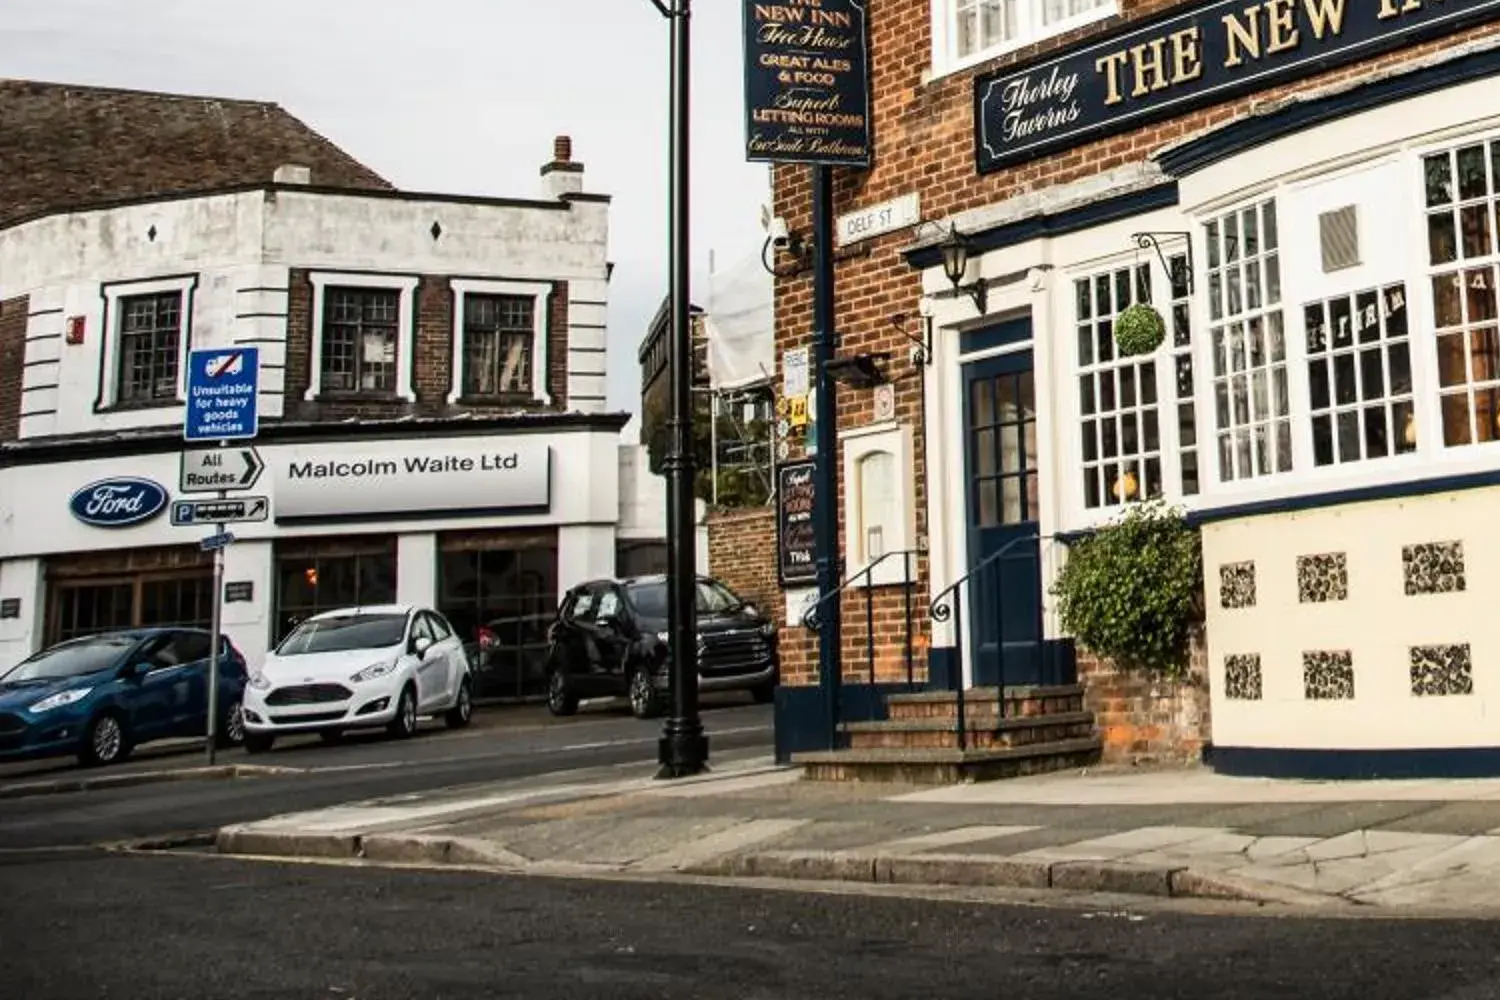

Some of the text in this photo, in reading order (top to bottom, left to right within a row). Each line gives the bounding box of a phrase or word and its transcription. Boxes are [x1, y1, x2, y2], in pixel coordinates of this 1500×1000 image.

[755, 4, 851, 28] NEW INN
[756, 23, 850, 48] Free House
[760, 53, 851, 72] GREAT ALES
[1096, 26, 1202, 106] THE
[778, 69, 836, 86] & FOOD
[1001, 66, 1078, 112] Thorley
[775, 90, 841, 111] Superb
[753, 108, 864, 127] LETTING ROOMS
[1002, 100, 1080, 142] Taverns
[806, 127, 829, 136] WITH
[879, 207, 893, 226] ST
[193, 384, 253, 397] Unsuitable
[196, 397, 249, 408] for heavy
[204, 409, 239, 423] goods
[198, 421, 243, 433] vehicles
[201, 454, 222, 466] All
[288, 453, 518, 479] Malcolm Waite Ltd
[187, 473, 236, 485] Routes
[86, 485, 145, 515] Ford
[180, 505, 191, 520] P
